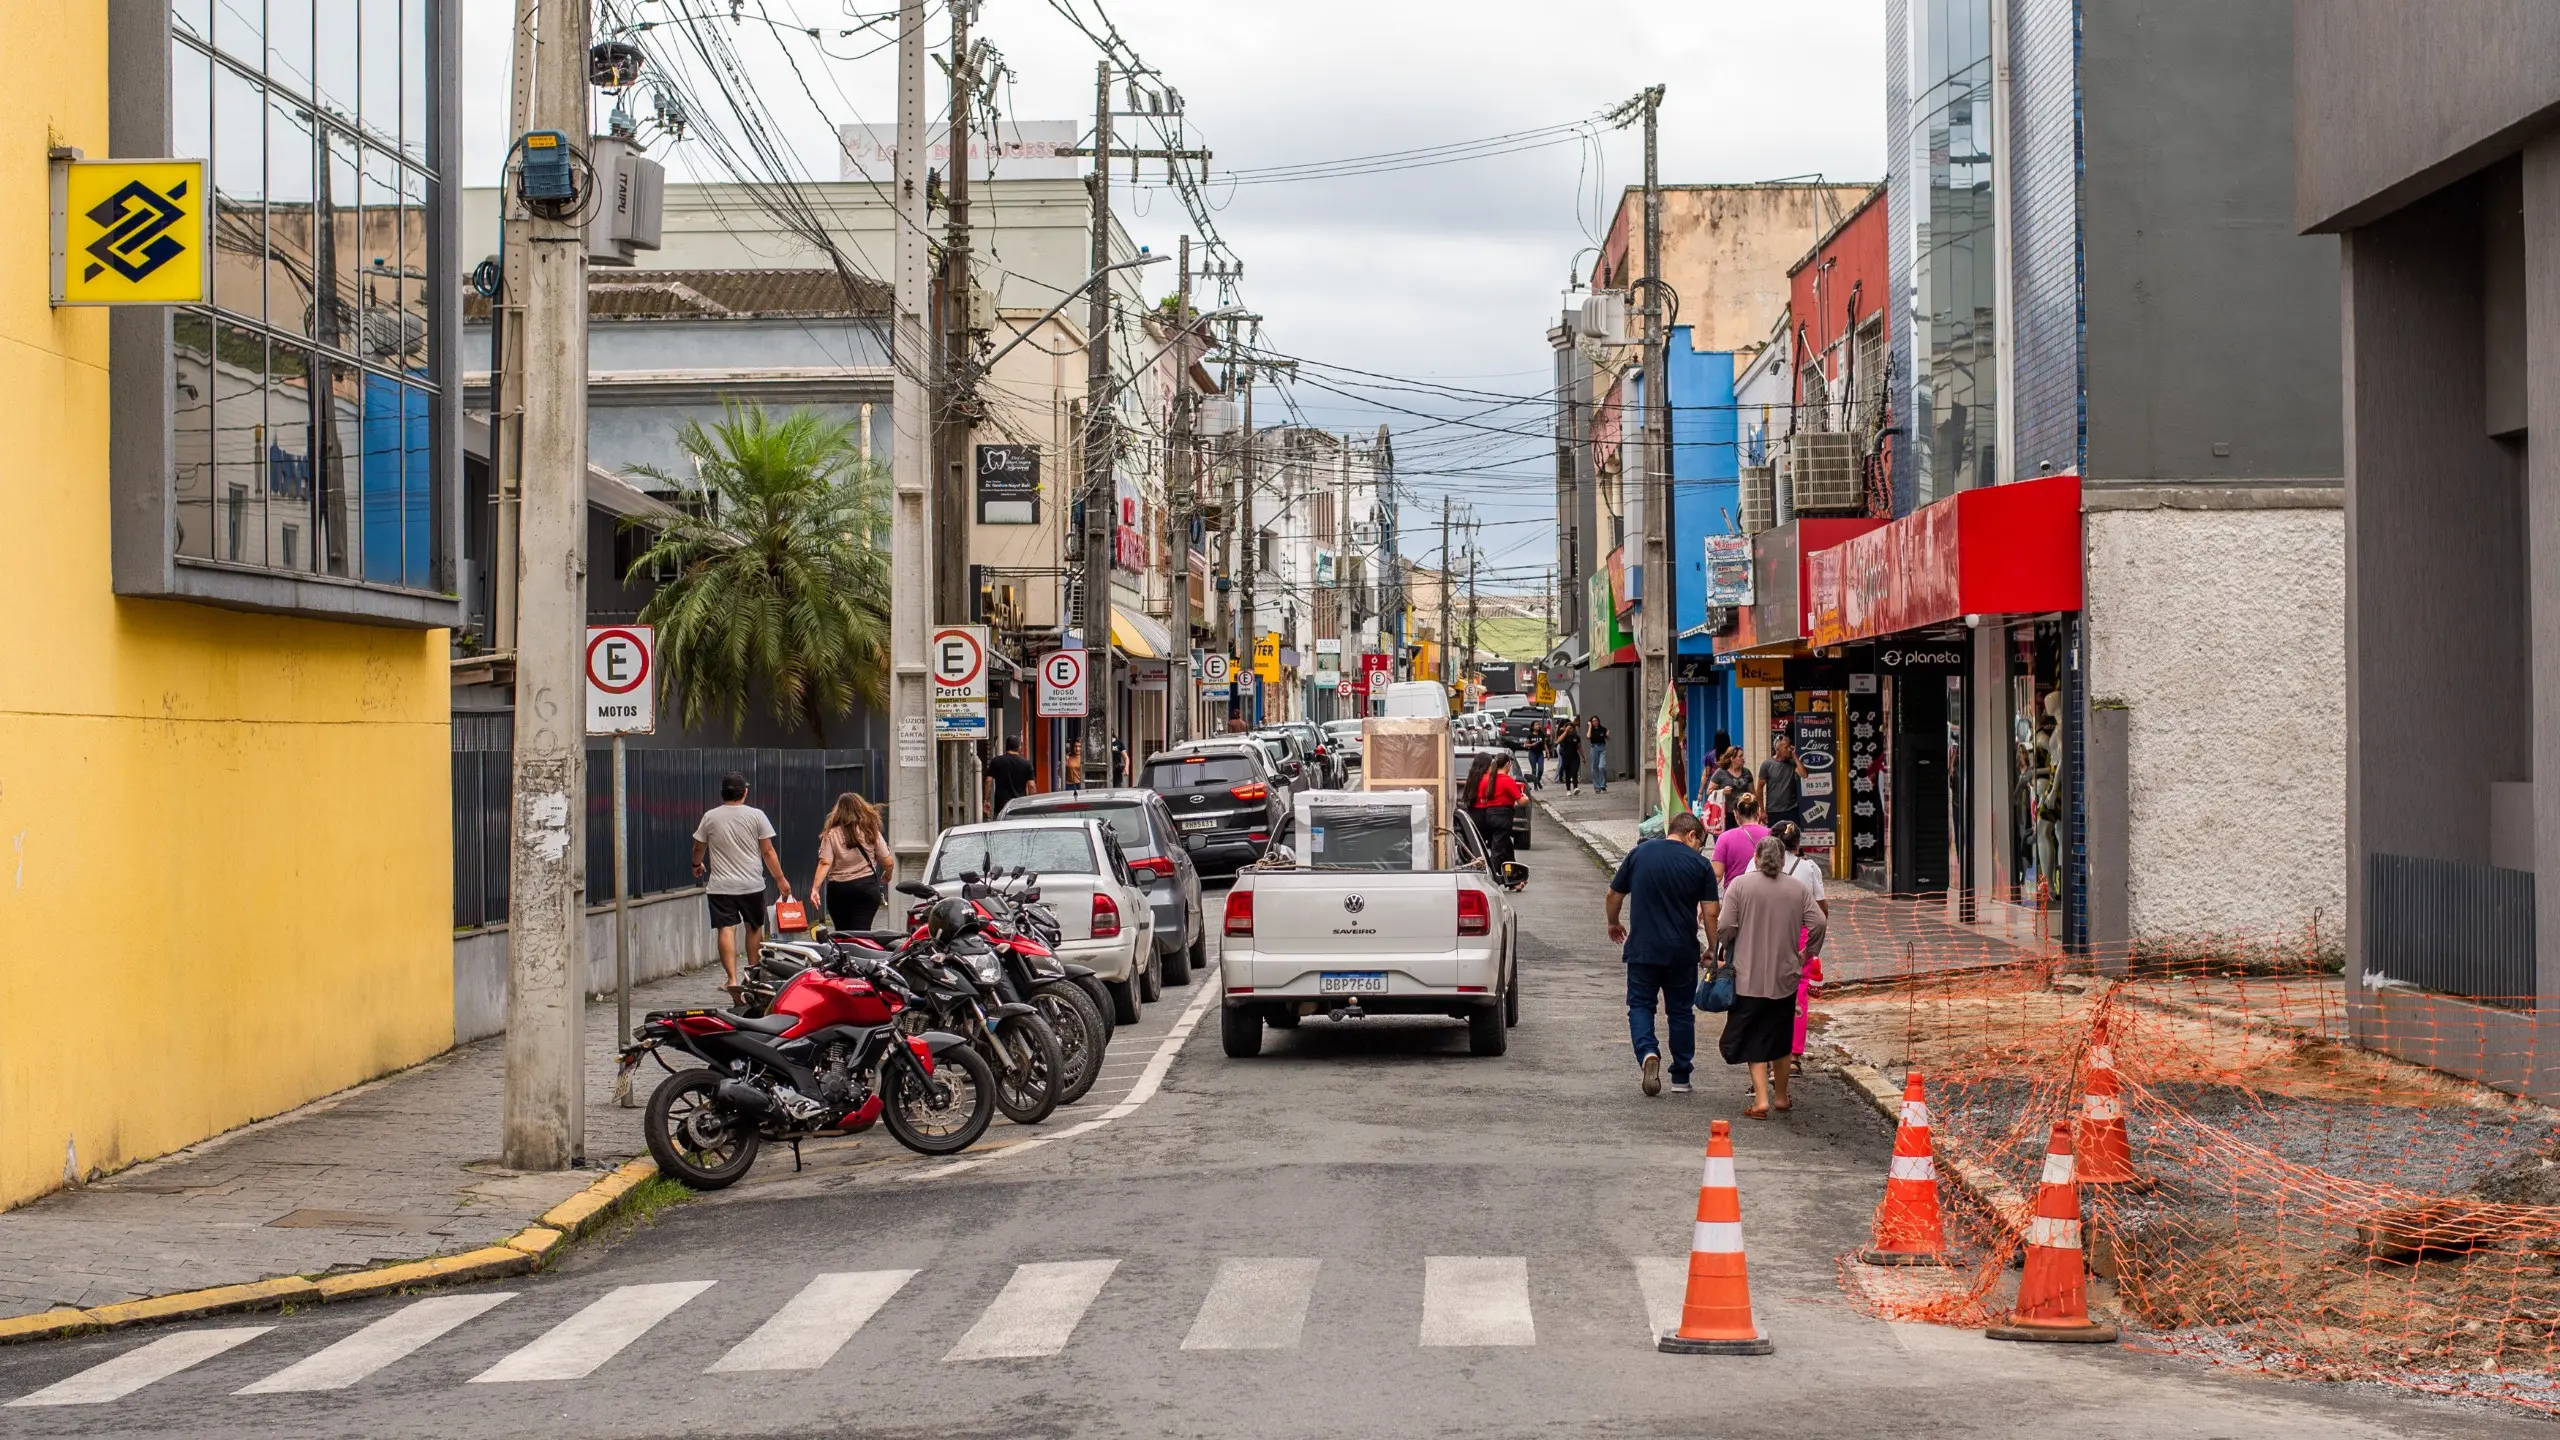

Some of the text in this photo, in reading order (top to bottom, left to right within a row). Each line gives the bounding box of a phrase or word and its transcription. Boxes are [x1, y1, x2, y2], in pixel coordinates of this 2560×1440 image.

[618, 173, 628, 214] ITAIPU
[606, 643, 627, 680] E
[943, 643, 964, 674] E
[1905, 650, 1961, 666] planeta
[1057, 662, 1068, 679] E
[1211, 660, 1221, 674] E
[1742, 667, 1761, 678] Rei
[1243, 673, 1249, 683] E
[1375, 674, 1381, 683] E
[936, 687, 971, 697] PertO
[598, 705, 638, 717] MOTOS
[1801, 728, 1832, 738] Buffet
[1801, 739, 1829, 751] Livre
[1808, 805, 1825, 819] SUBA
[1325, 978, 1381, 991] BBP7F60
